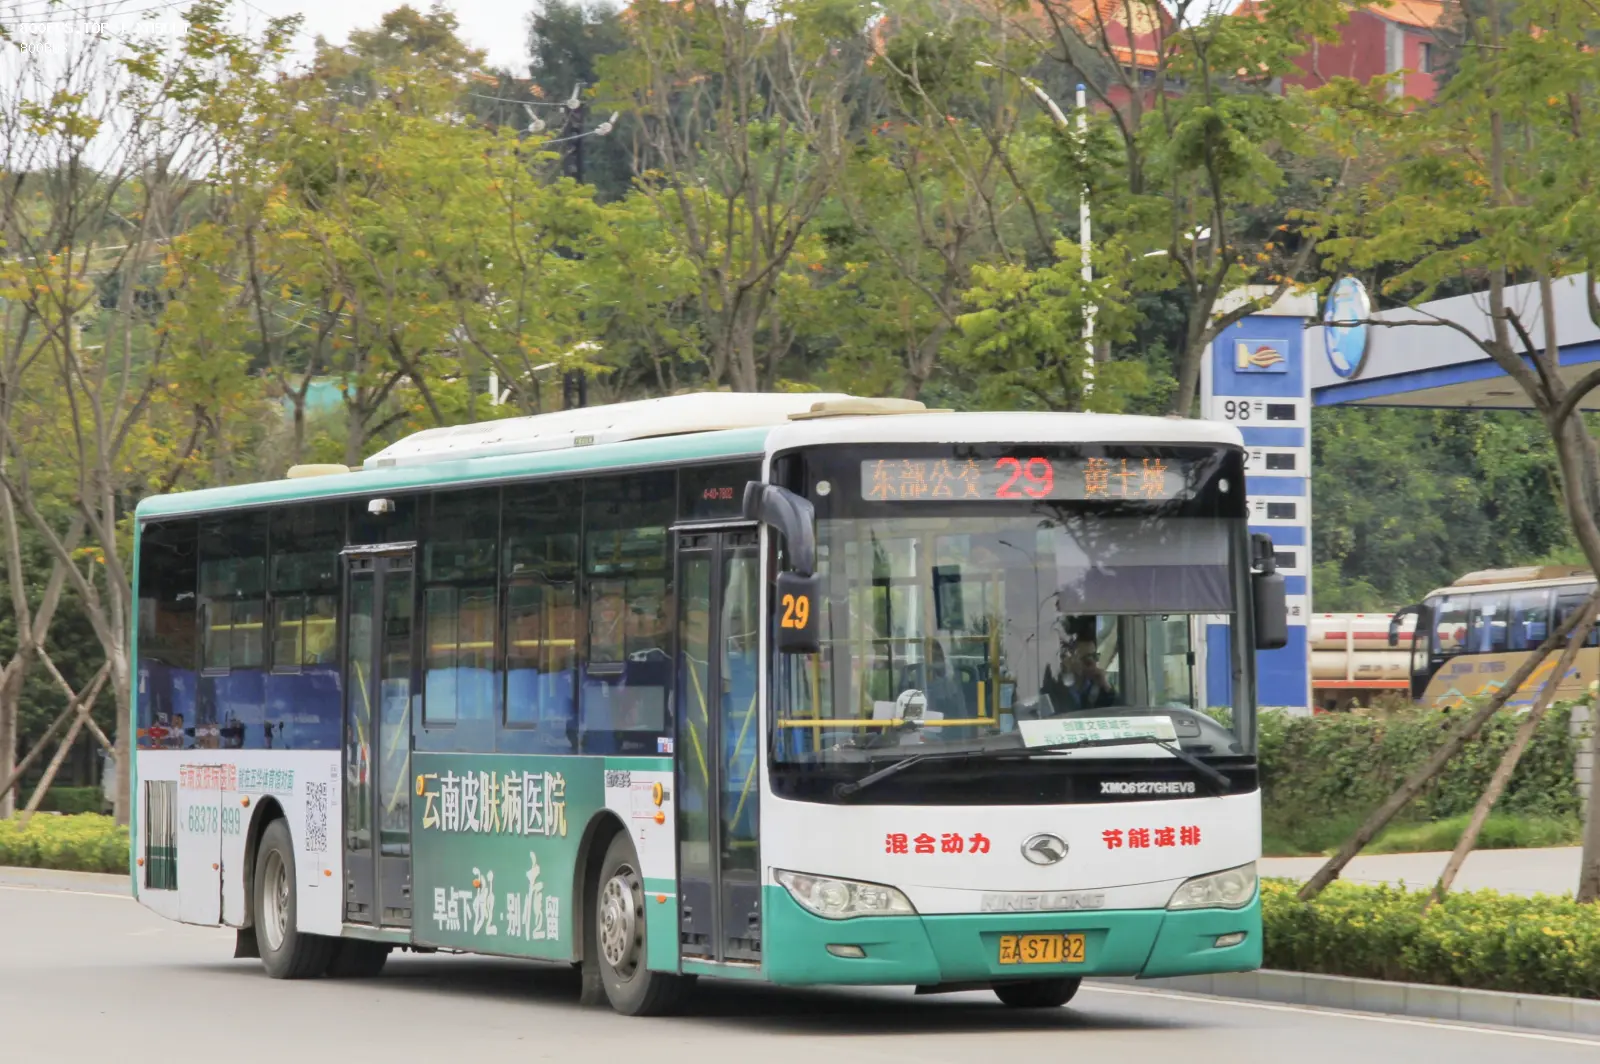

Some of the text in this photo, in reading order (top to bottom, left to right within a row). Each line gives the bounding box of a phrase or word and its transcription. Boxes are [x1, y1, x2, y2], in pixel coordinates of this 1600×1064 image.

[1224, 400, 1250, 420] 98
[869, 458, 981, 499] 东部公交
[994, 456, 1054, 498] 29
[780, 593, 810, 630] 29
[422, 769, 568, 836] 云南皮肤病医院
[188, 804, 240, 834] 68378999
[885, 832, 991, 855] 混合动力
[1101, 825, 1202, 850] 节能减排
